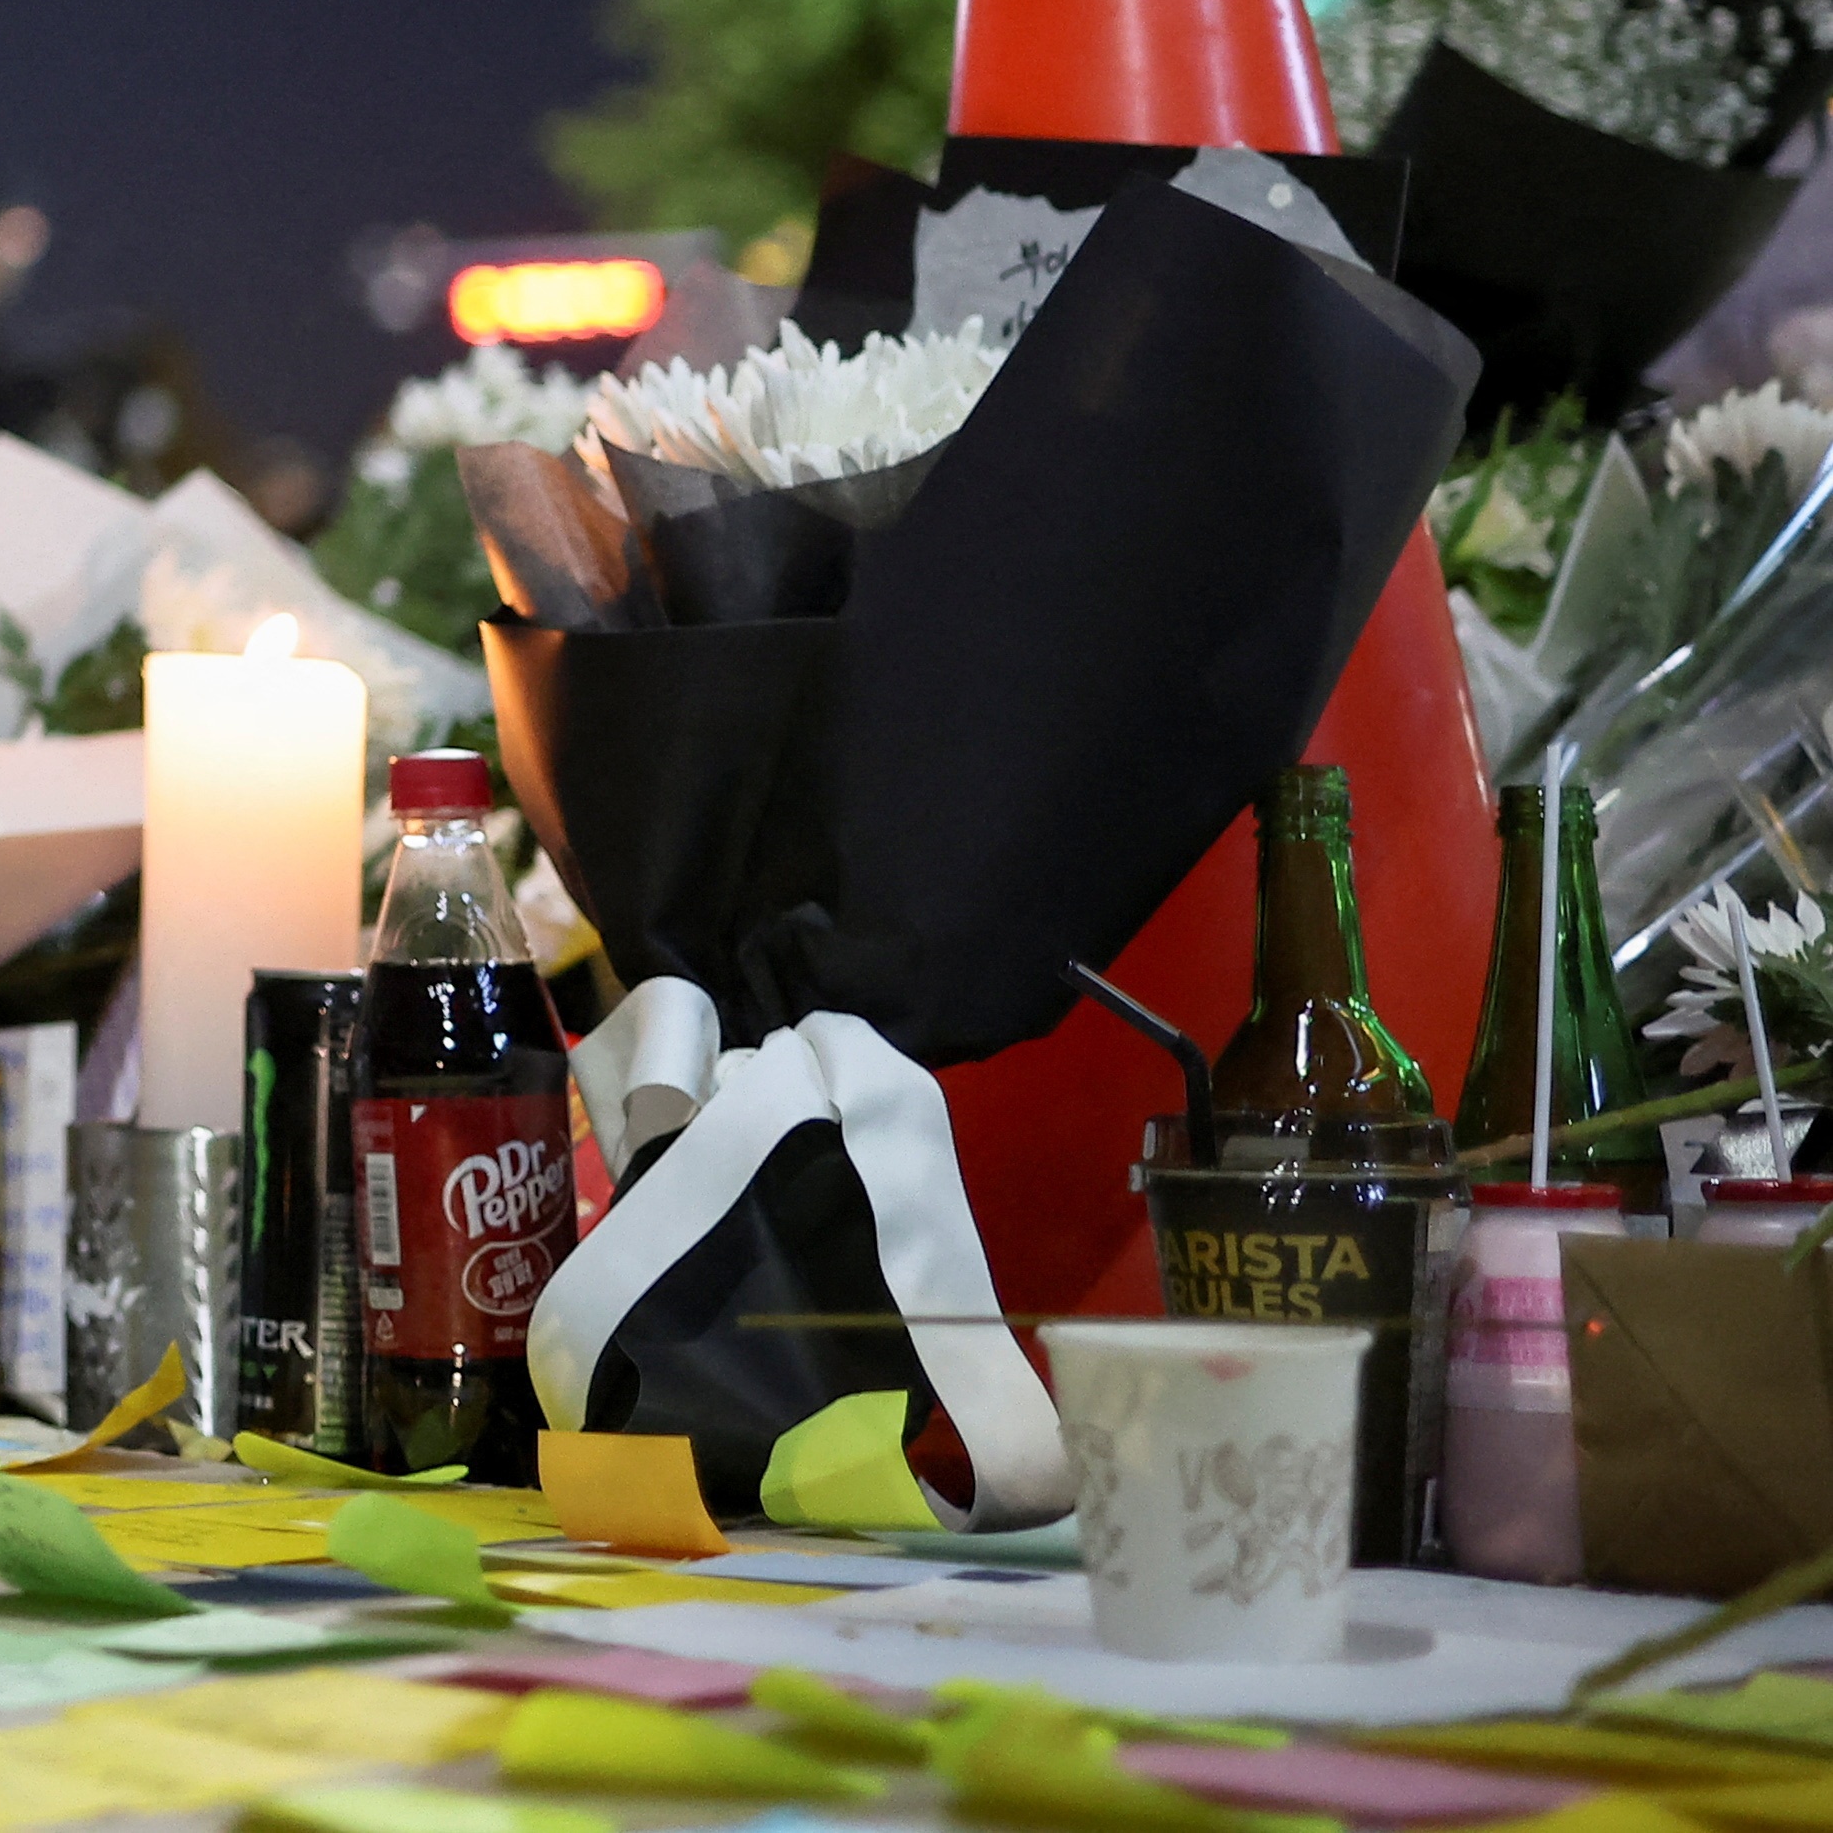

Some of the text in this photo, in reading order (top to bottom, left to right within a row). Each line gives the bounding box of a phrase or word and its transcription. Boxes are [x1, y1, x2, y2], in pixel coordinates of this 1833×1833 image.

[497, 1140, 546, 1188] Dr
[1161, 1229, 1370, 1281] ARISTA
[240, 1316, 316, 1358] TER
